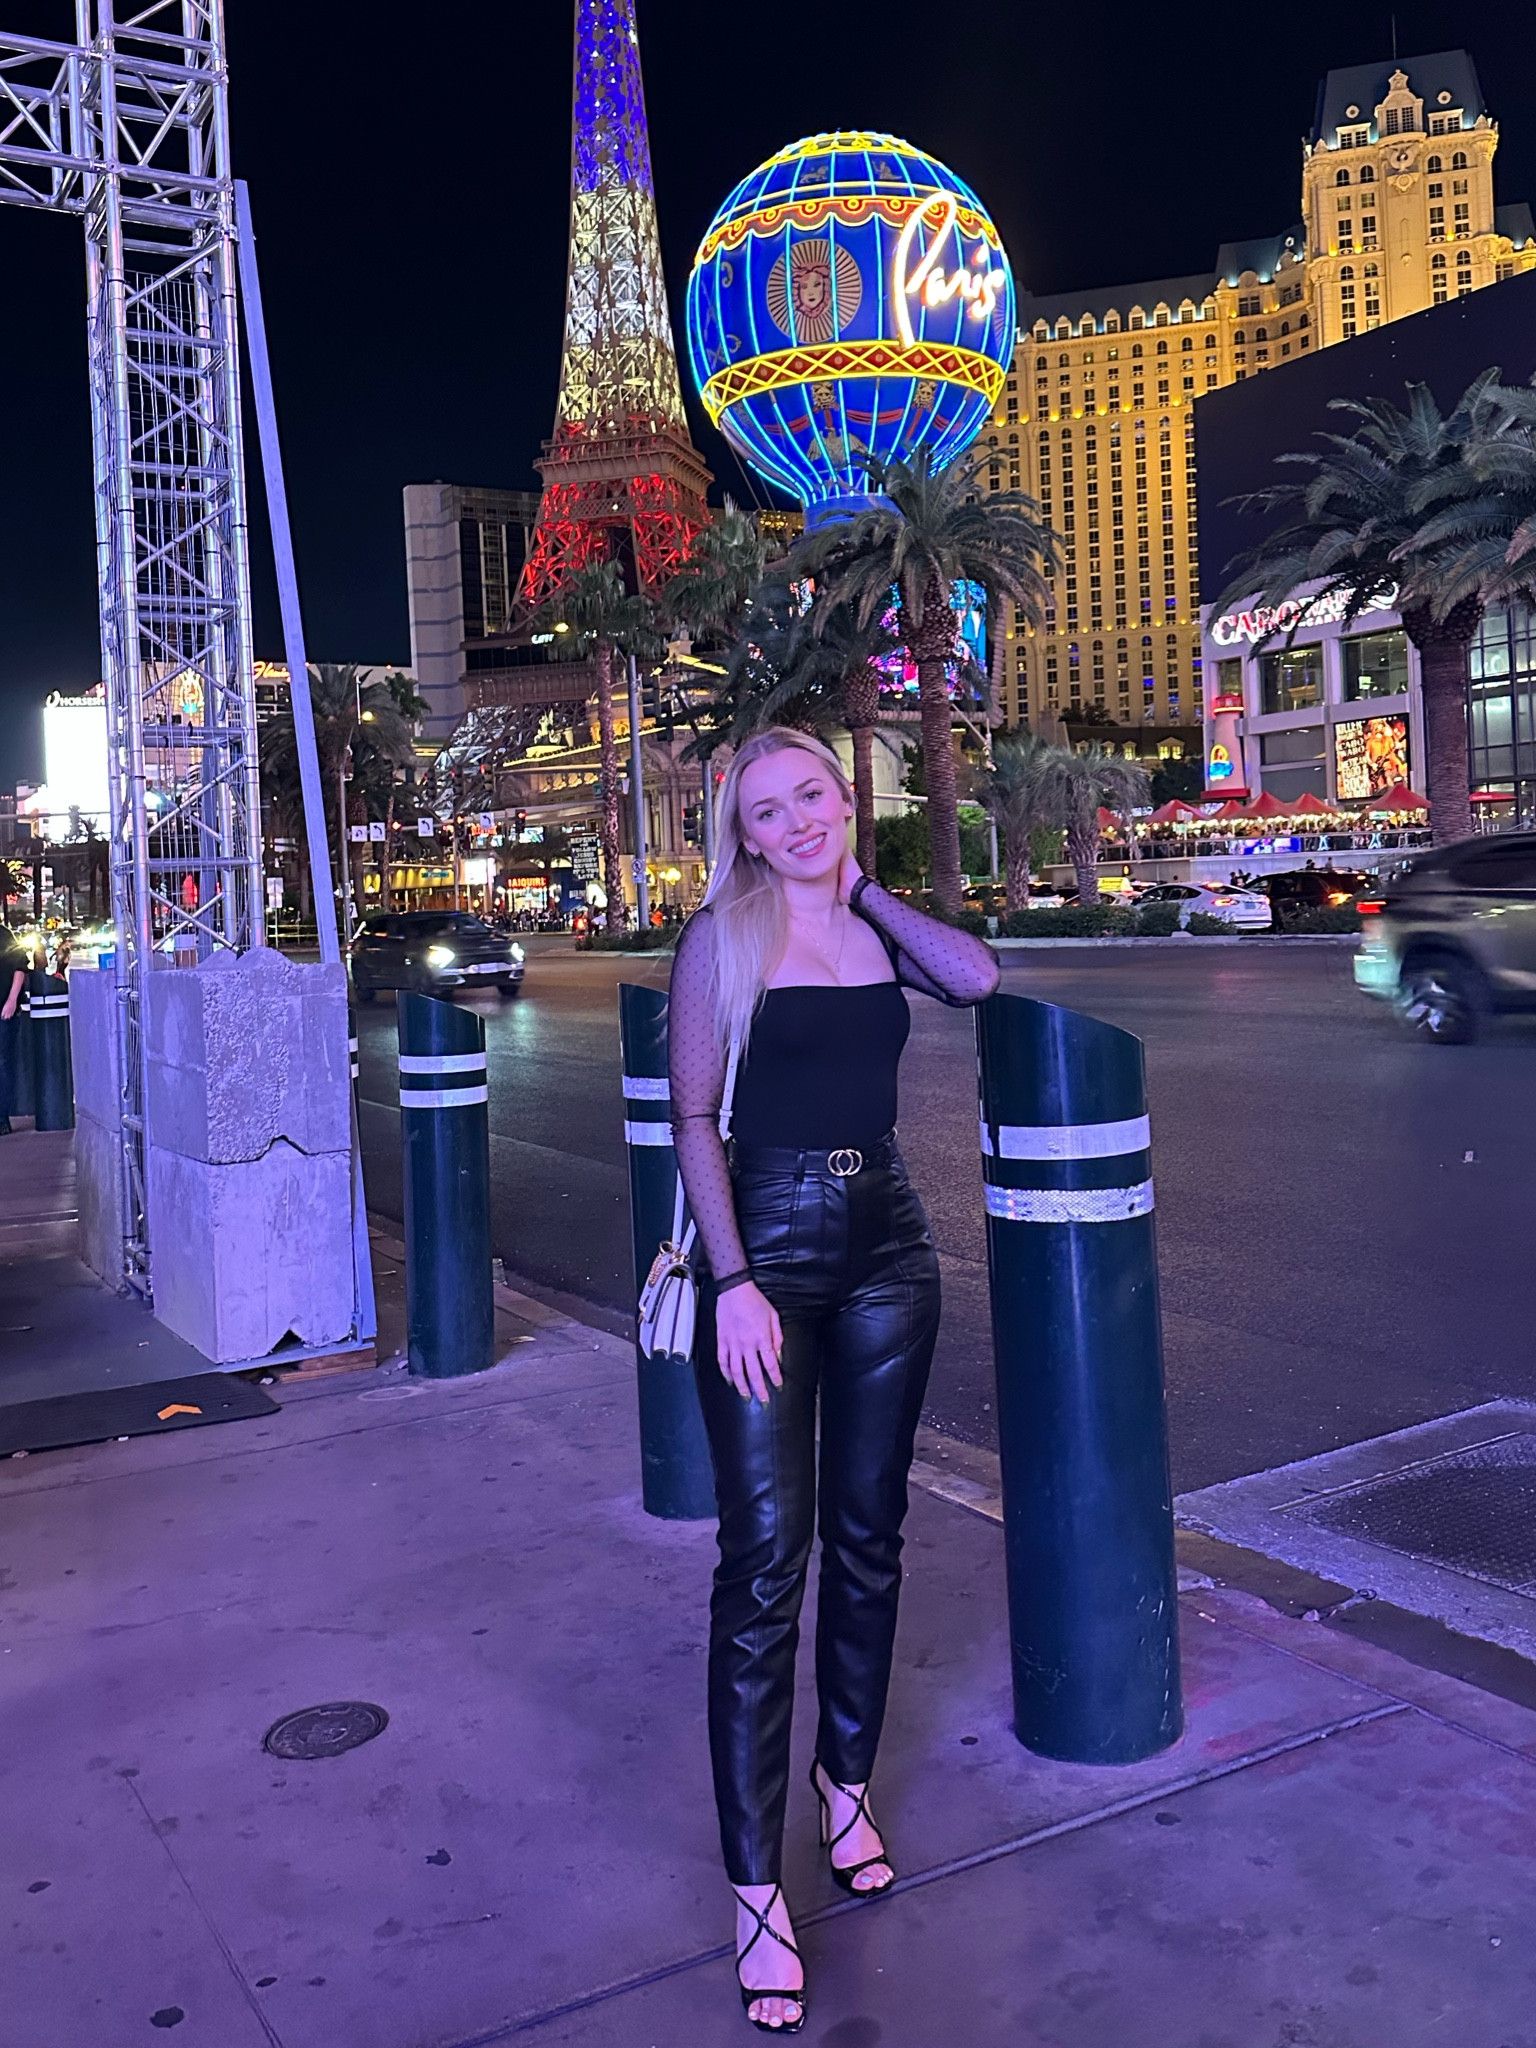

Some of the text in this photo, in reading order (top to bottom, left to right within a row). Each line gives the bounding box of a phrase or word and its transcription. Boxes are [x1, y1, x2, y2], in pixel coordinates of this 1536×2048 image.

[894, 190, 1005, 349] Paris
[1211, 601, 1301, 646] CABO
[60, 697, 106, 706] HORSESH
[1340, 737, 1364, 751] CABO
[1343, 775, 1371, 792] ROCK
